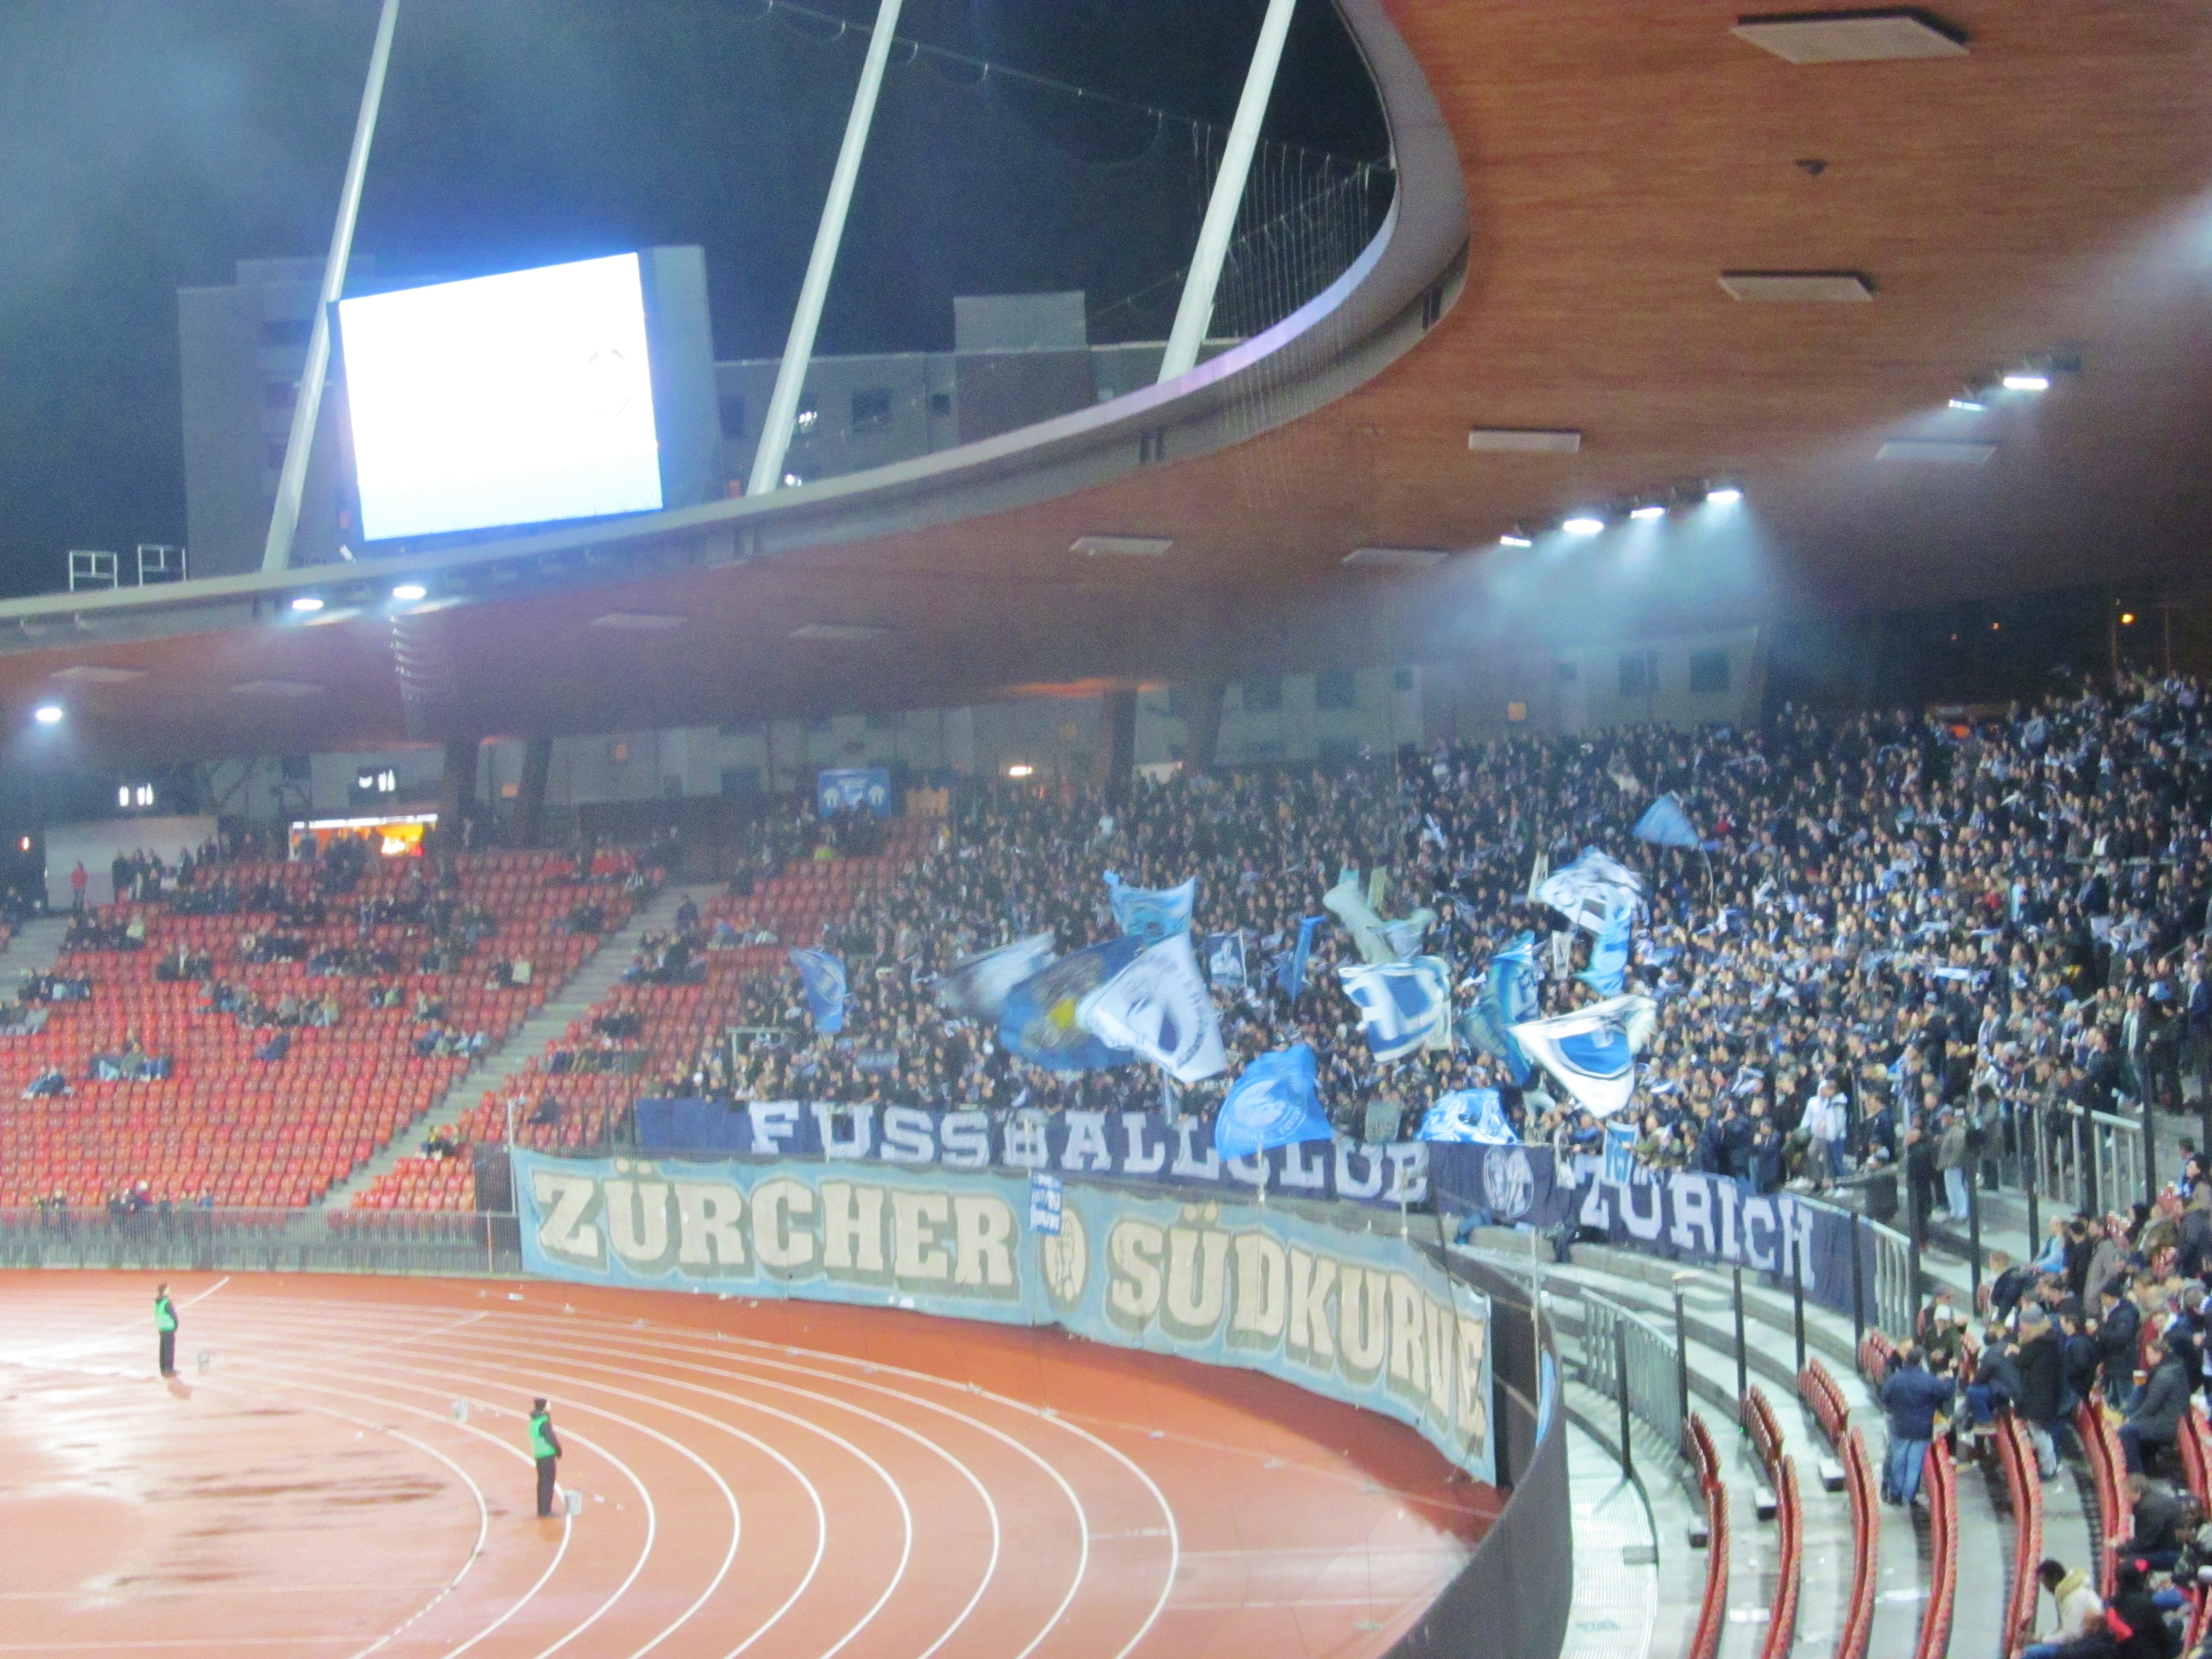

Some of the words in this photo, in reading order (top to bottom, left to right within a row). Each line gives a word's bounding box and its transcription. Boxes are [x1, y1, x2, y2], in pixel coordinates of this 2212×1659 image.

[533, 1159, 1015, 1287] ZÜRCHER
[1111, 1203, 1490, 1421] SÜDKURVE
[1575, 1154, 1816, 1291] ZÜRICH
